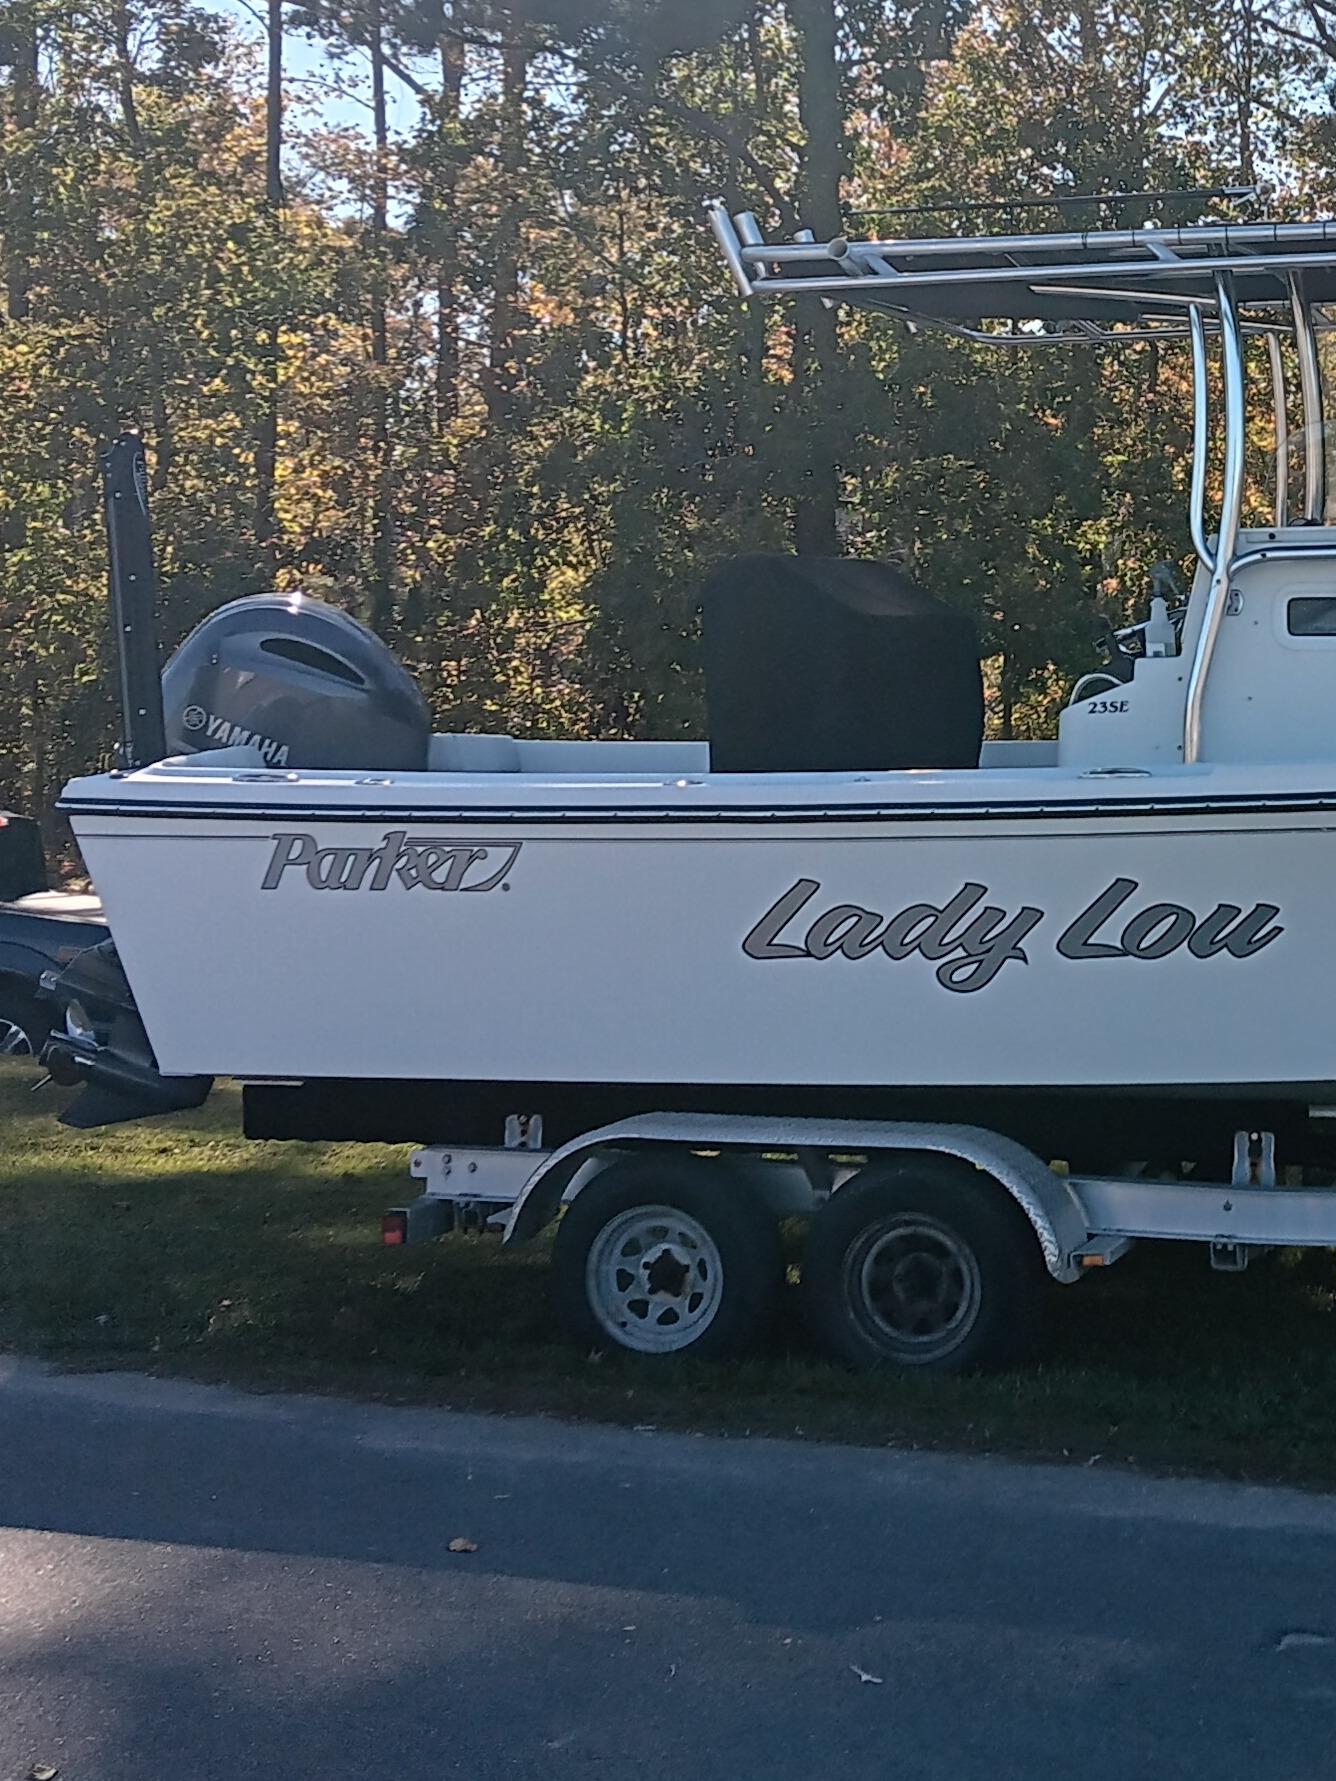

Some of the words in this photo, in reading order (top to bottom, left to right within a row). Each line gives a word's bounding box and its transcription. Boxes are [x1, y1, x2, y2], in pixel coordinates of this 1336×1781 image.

[1088, 700, 1129, 714] 23SE
[206, 714, 290, 767] YAMAHA
[260, 830, 489, 892] Parker
[741, 877, 1044, 994] Lady
[1056, 877, 1285, 960] Lou
